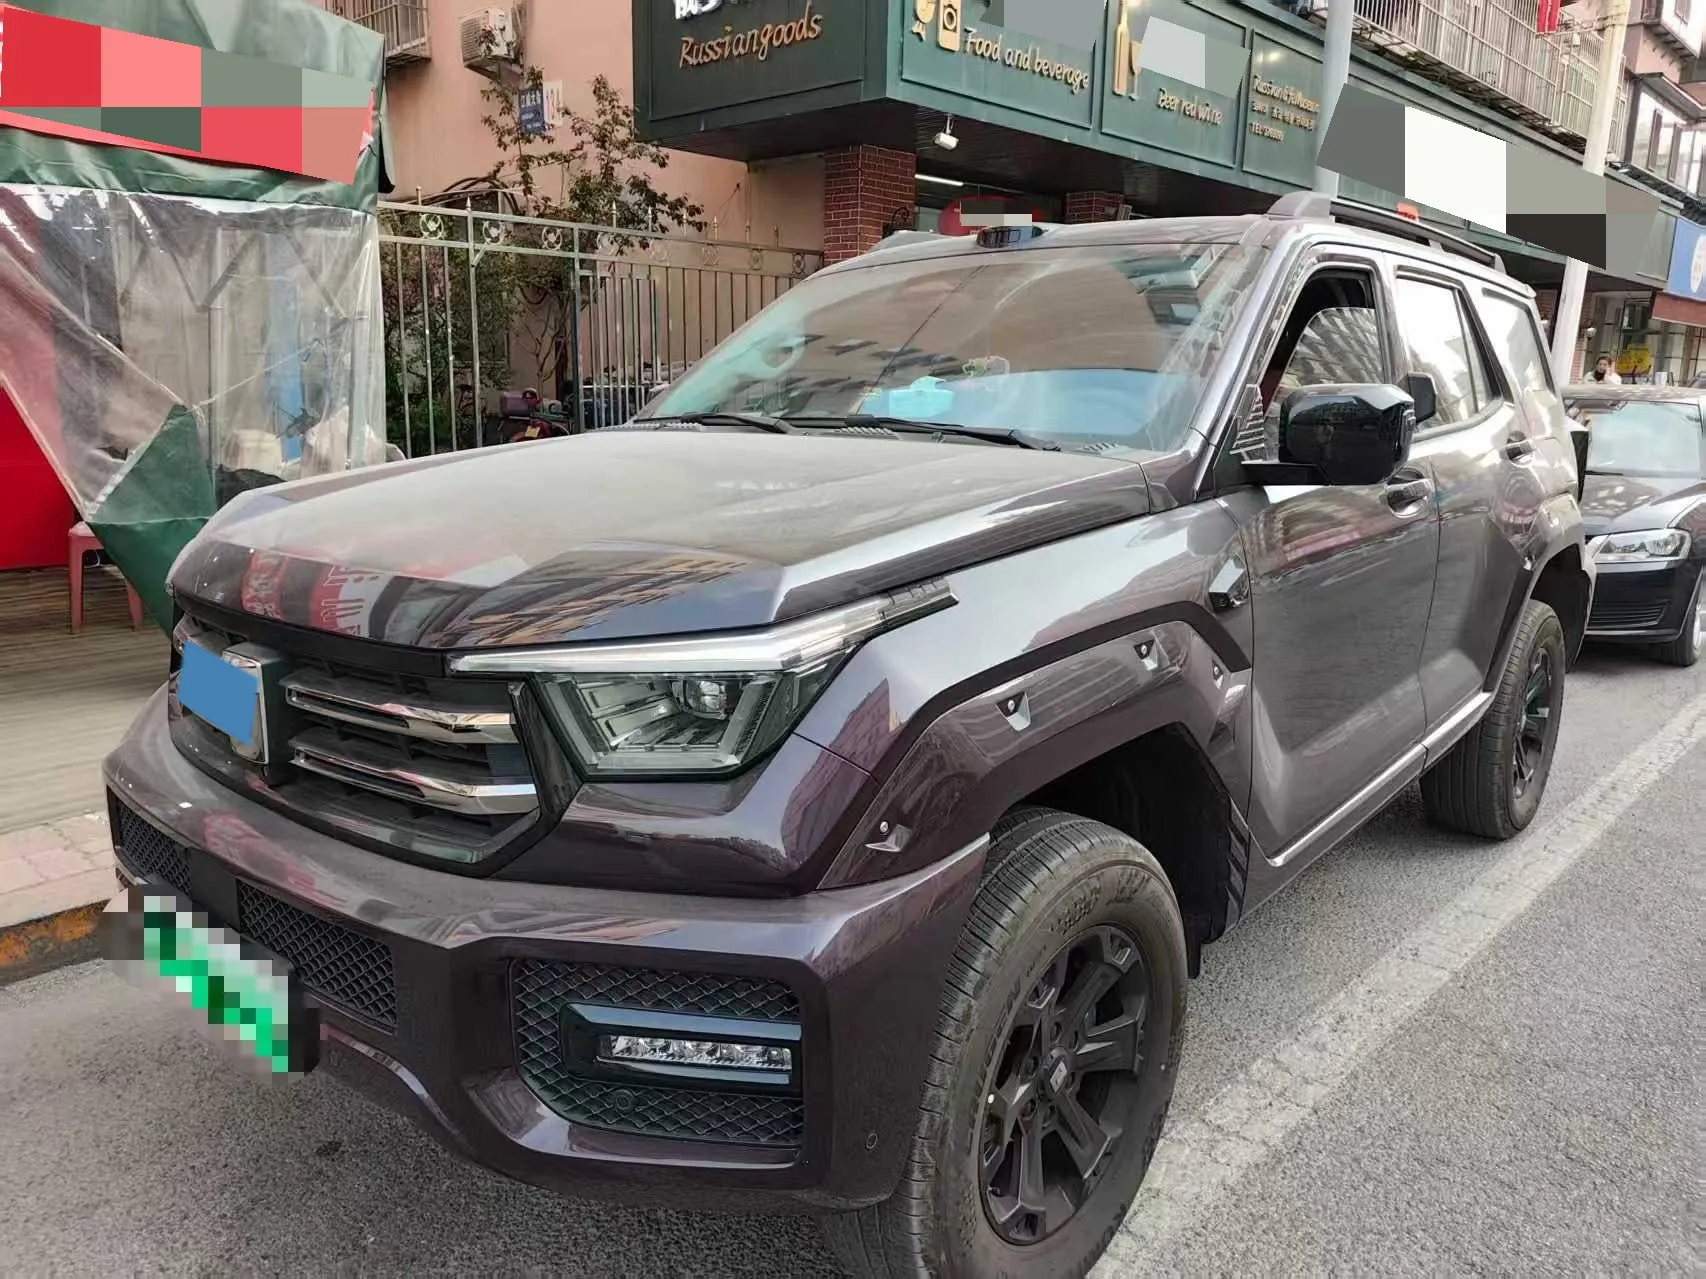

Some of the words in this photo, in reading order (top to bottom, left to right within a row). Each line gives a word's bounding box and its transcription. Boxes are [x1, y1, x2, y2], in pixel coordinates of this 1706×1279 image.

[963, 27, 1002, 61] Food
[1005, 43, 1032, 70] and
[1034, 47, 1089, 95] beverage
